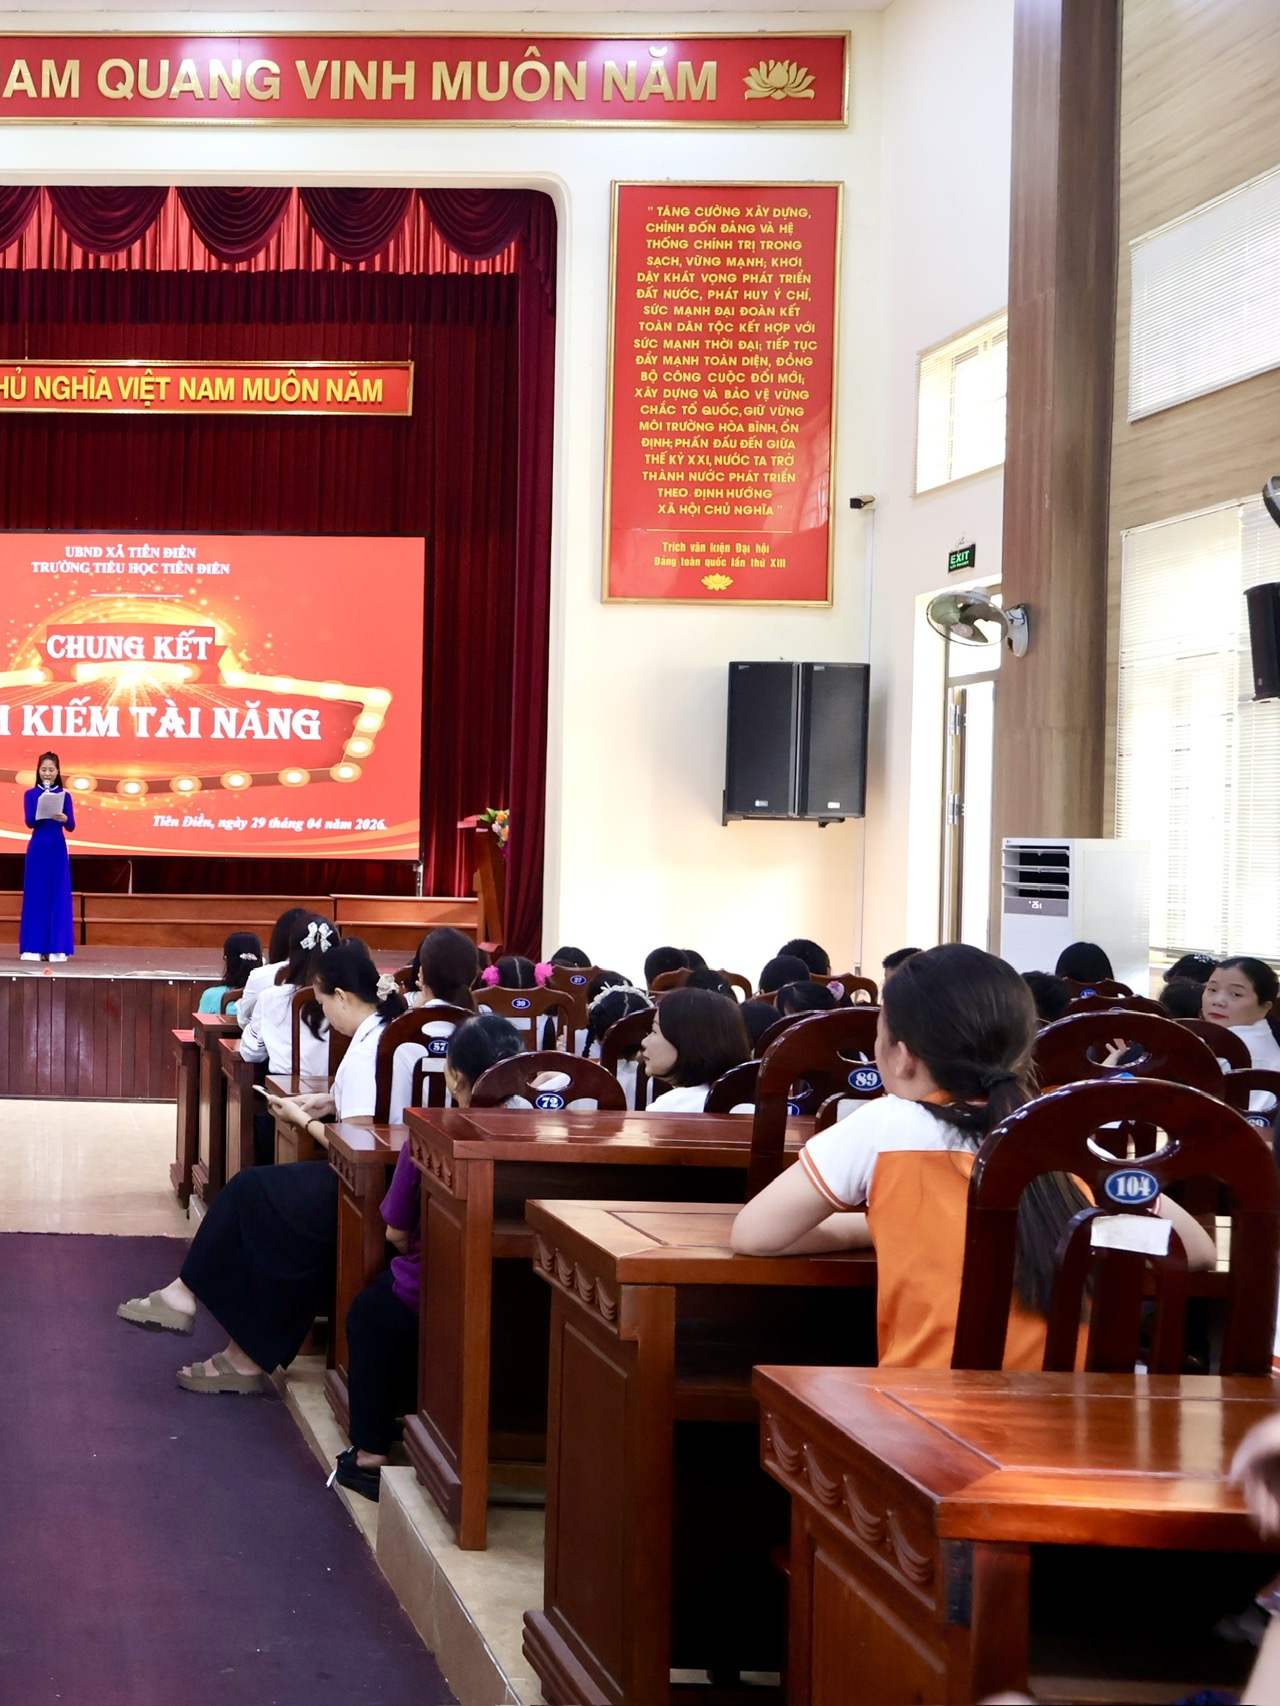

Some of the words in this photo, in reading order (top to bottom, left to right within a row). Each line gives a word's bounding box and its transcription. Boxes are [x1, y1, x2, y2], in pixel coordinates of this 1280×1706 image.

[97, 58, 281, 101] QUANG
[295, 61, 415, 100] VINH
[432, 46, 588, 102] MUÔN
[602, 45, 717, 101] NĂM
[646, 220, 684, 233] CHỈNH
[688, 220, 716, 233] ĐỐN
[720, 221, 756, 234] ĐẢNG
[760, 222, 775, 233] VÀ
[780, 223, 794, 236] HỆ
[638, 270, 660, 284] DẬY
[664, 271, 695, 282] KHÁT
[701, 274, 737, 286] VỌNG
[743, 271, 773, 283] PHÁT
[779, 270, 811, 284] TRIỂN
[636, 286, 658, 299] ĐẤT
[664, 287, 702, 301] NƯỚC,
[708, 287, 739, 300] PHÁT
[744, 290, 768, 300] HUY
[774, 288, 781, 300] Ý
[786, 288, 811, 302] CHÍ,
[639, 320, 672, 331] TOÀN
[677, 321, 702, 332] DÂN
[708, 320, 734, 335] TỘC
[740, 319, 760, 332] KẾT
[765, 322, 791, 335] HỢP
[795, 321, 815, 333] VỚI
[34, 369, 113, 402] NGHĨA
[117, 368, 171, 407] VIỆT
[179, 377, 235, 402] NAM
[242, 369, 319, 402] MUÔN
[325, 371, 383, 403] NĂM
[635, 386, 658, 398] XÂY
[664, 388, 699, 401] DỰNG
[703, 387, 718, 399] VÀ
[725, 386, 750, 399] BẢO
[755, 388, 769, 402] VỆ
[774, 388, 809, 400] VỮNG
[640, 419, 662, 431] MÔI
[666, 420, 715, 432] TRƯỜNG
[719, 420, 744, 432] HÒA
[748, 421, 778, 434] BÌNH,
[642, 469, 684, 481] THÀNH
[689, 469, 725, 482] NƯỚC
[730, 470, 759, 482] PHÁT
[763, 469, 796, 483] TRIỂN
[658, 488, 688, 497] THEO
[694, 489, 724, 500] ĐỊNH
[727, 486, 773, 499] HƯỚNG
[65, 546, 103, 558] UBND
[128, 543, 160, 558] TIÊN
[950, 550, 969, 564] EXIT
[31, 559, 90, 573] TRƯỜNG
[128, 562, 159, 576] HỌC
[161, 560, 194, 574] TIÊN
[770, 559, 786, 568] XIII
[46, 634, 145, 660] CHUNG
[153, 630, 213, 660] KẾT
[21, 696, 120, 737] KIẾM
[129, 699, 202, 738] TÀI
[210, 700, 322, 740] NĂNG
[153, 815, 180, 827] Tiên
[217, 816, 248, 831] ngày
[250, 817, 266, 828] 29
[268, 817, 304, 832] tháng
[306, 818, 322, 829] 04
[324, 818, 352, 830] năm
[354, 818, 387, 830] 2026.
[433, 1042, 446, 1051] 57
[855, 1072, 878, 1086] 89
[541, 1097, 558, 1108] 72
[1116, 1176, 1150, 1197] 104
